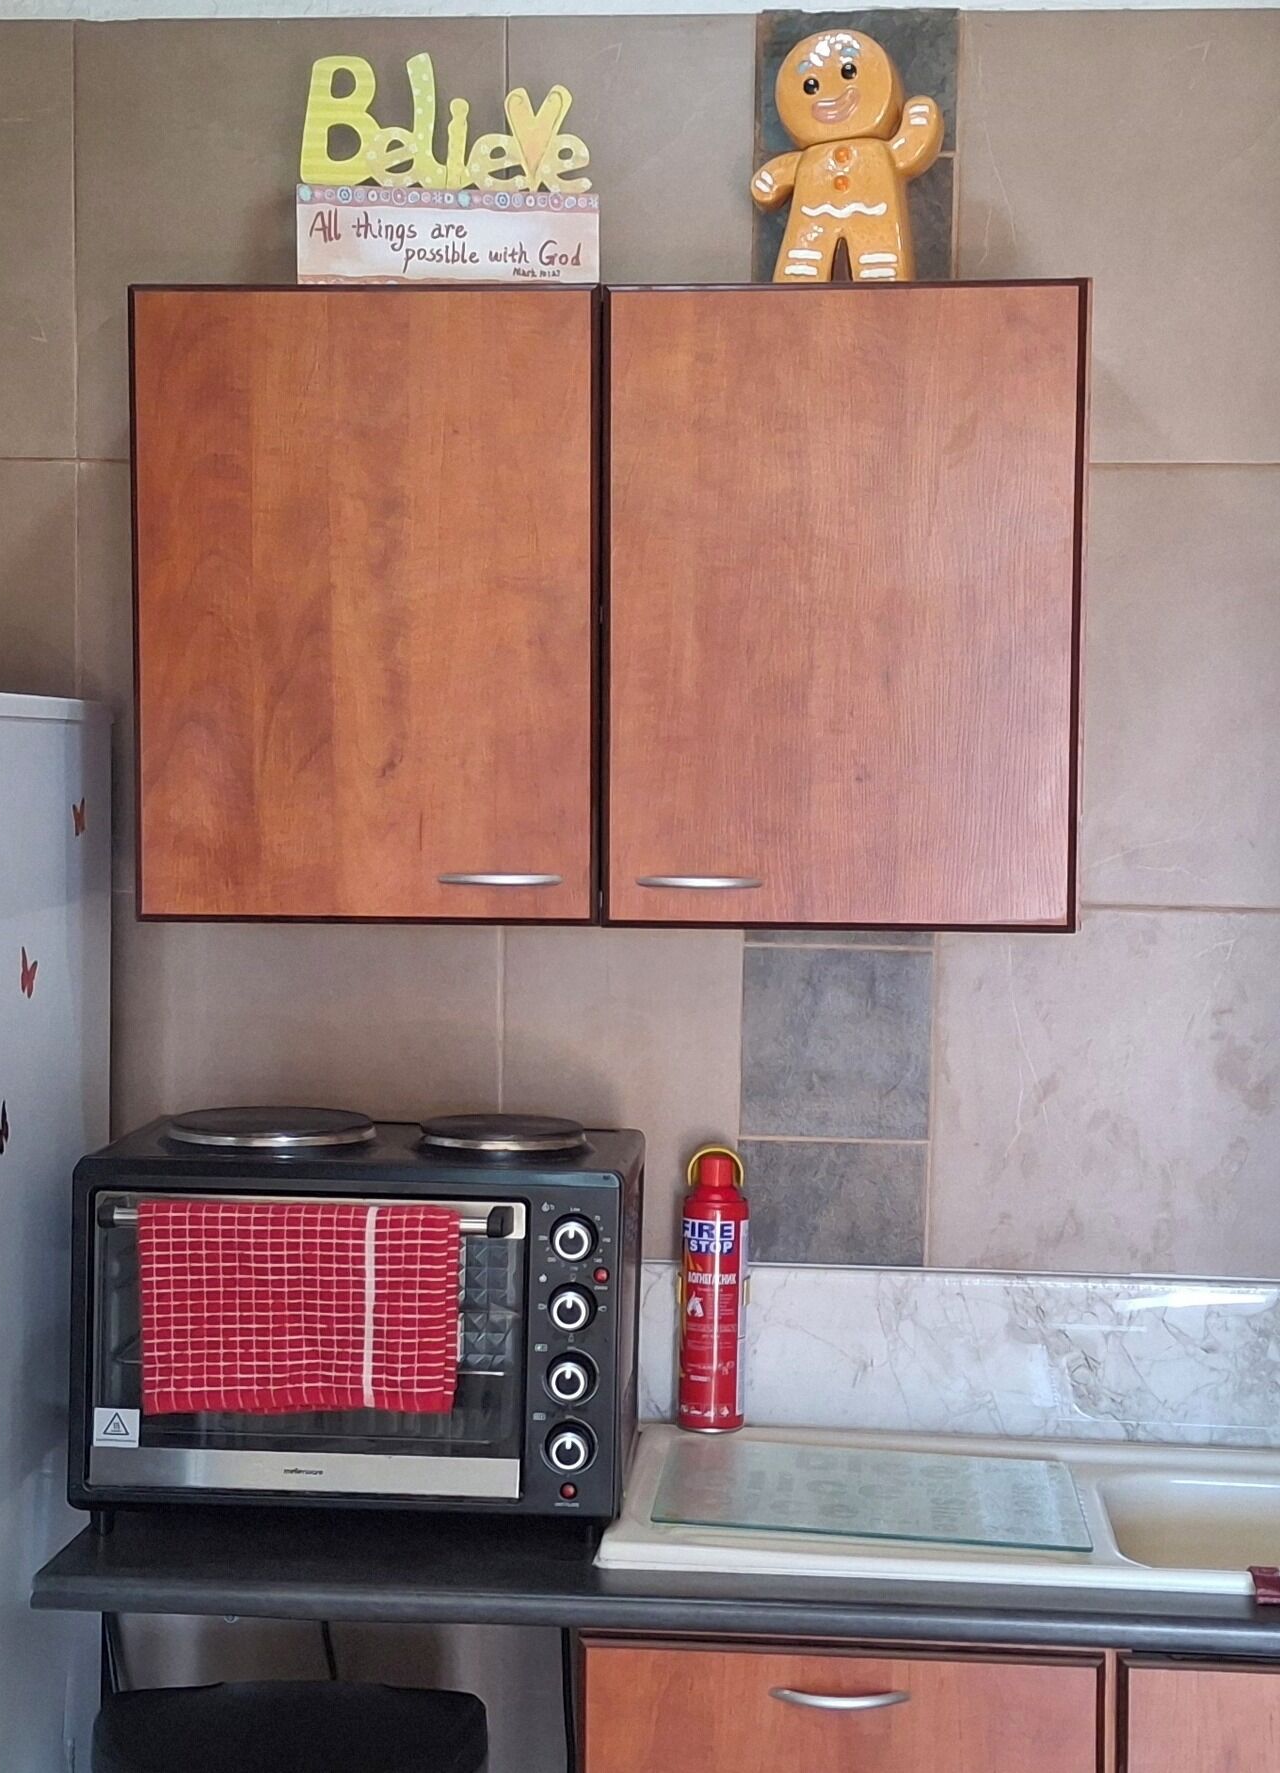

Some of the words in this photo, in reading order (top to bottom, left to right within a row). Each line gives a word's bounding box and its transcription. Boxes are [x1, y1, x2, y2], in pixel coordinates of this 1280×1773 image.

[300, 52, 593, 193] Believe
[309, 209, 342, 244] All
[351, 210, 418, 252] things
[430, 220, 468, 240] are
[402, 241, 480, 274] possible
[488, 242, 529, 265] with
[538, 240, 582, 267] God
[683, 1220, 734, 1239] FIRE
[689, 1240, 733, 1253] STOP
